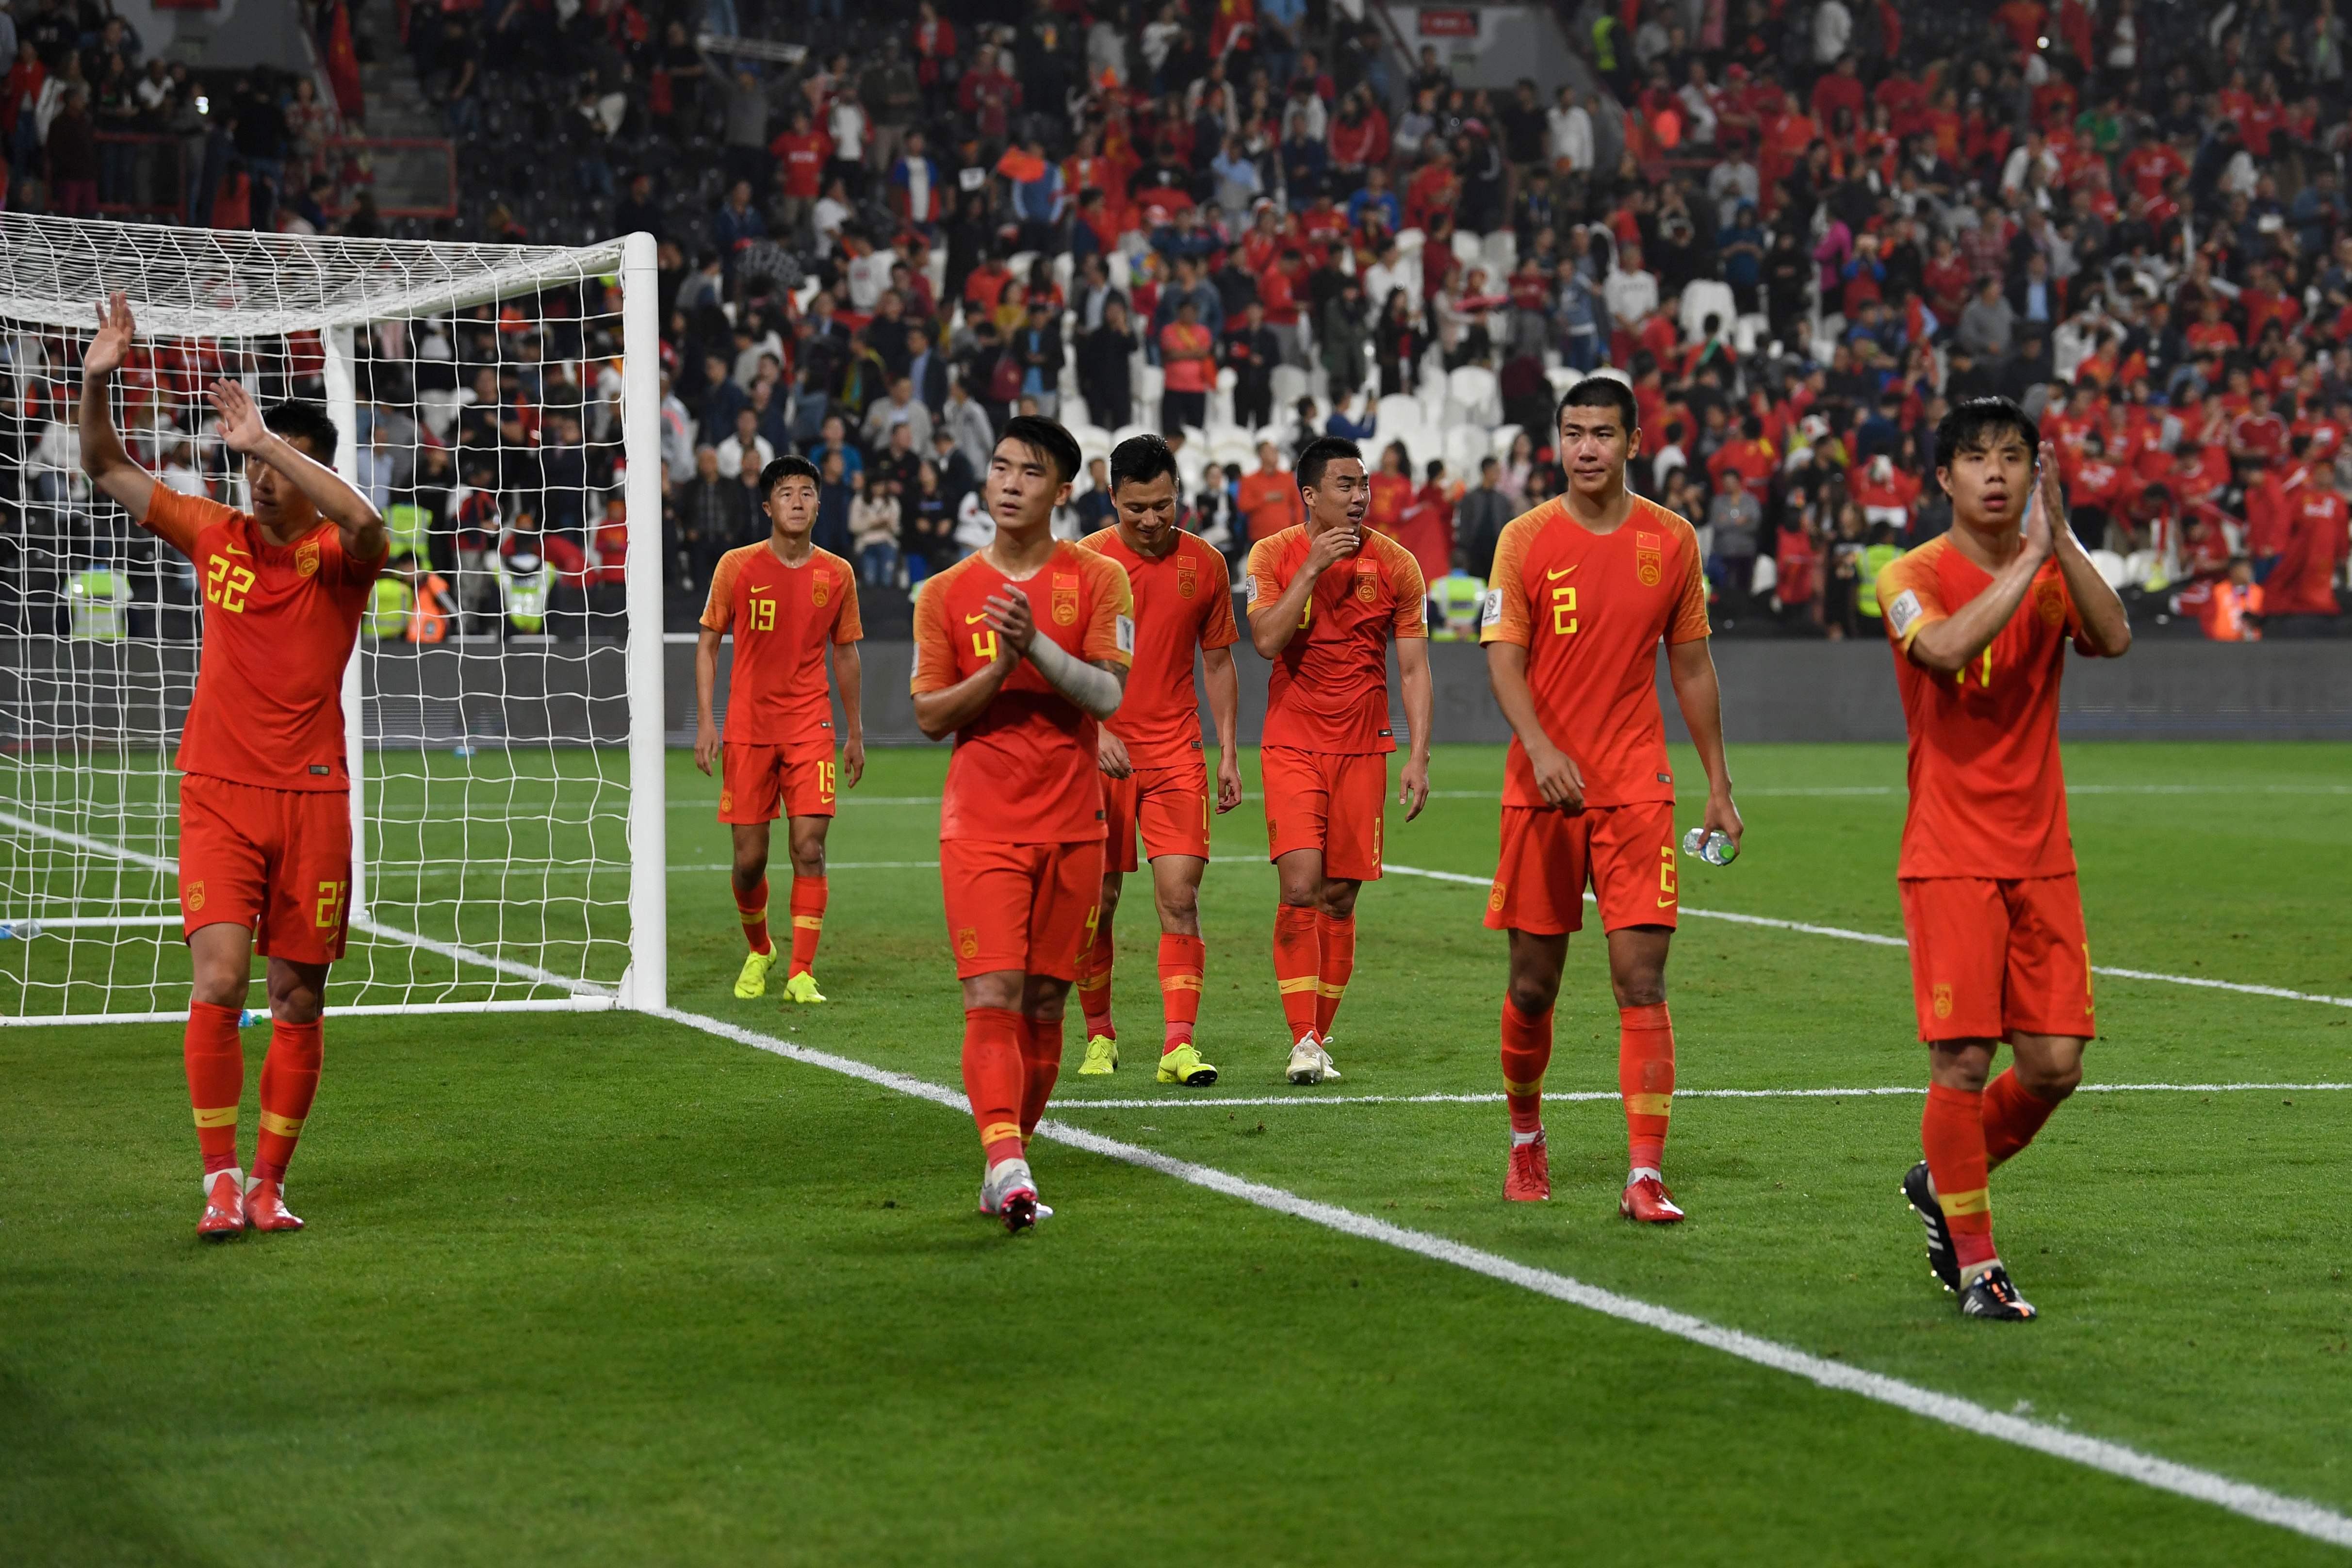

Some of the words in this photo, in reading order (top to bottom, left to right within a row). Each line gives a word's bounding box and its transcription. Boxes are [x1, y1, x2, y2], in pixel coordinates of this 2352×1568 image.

[207, 554, 256, 613] 22
[749, 599, 776, 631] 19
[1552, 587, 1577, 635] 2
[972, 630, 997, 663] 4
[817, 761, 835, 793] 19
[1661, 846, 1675, 894] 2
[1085, 905, 1100, 948] 4
